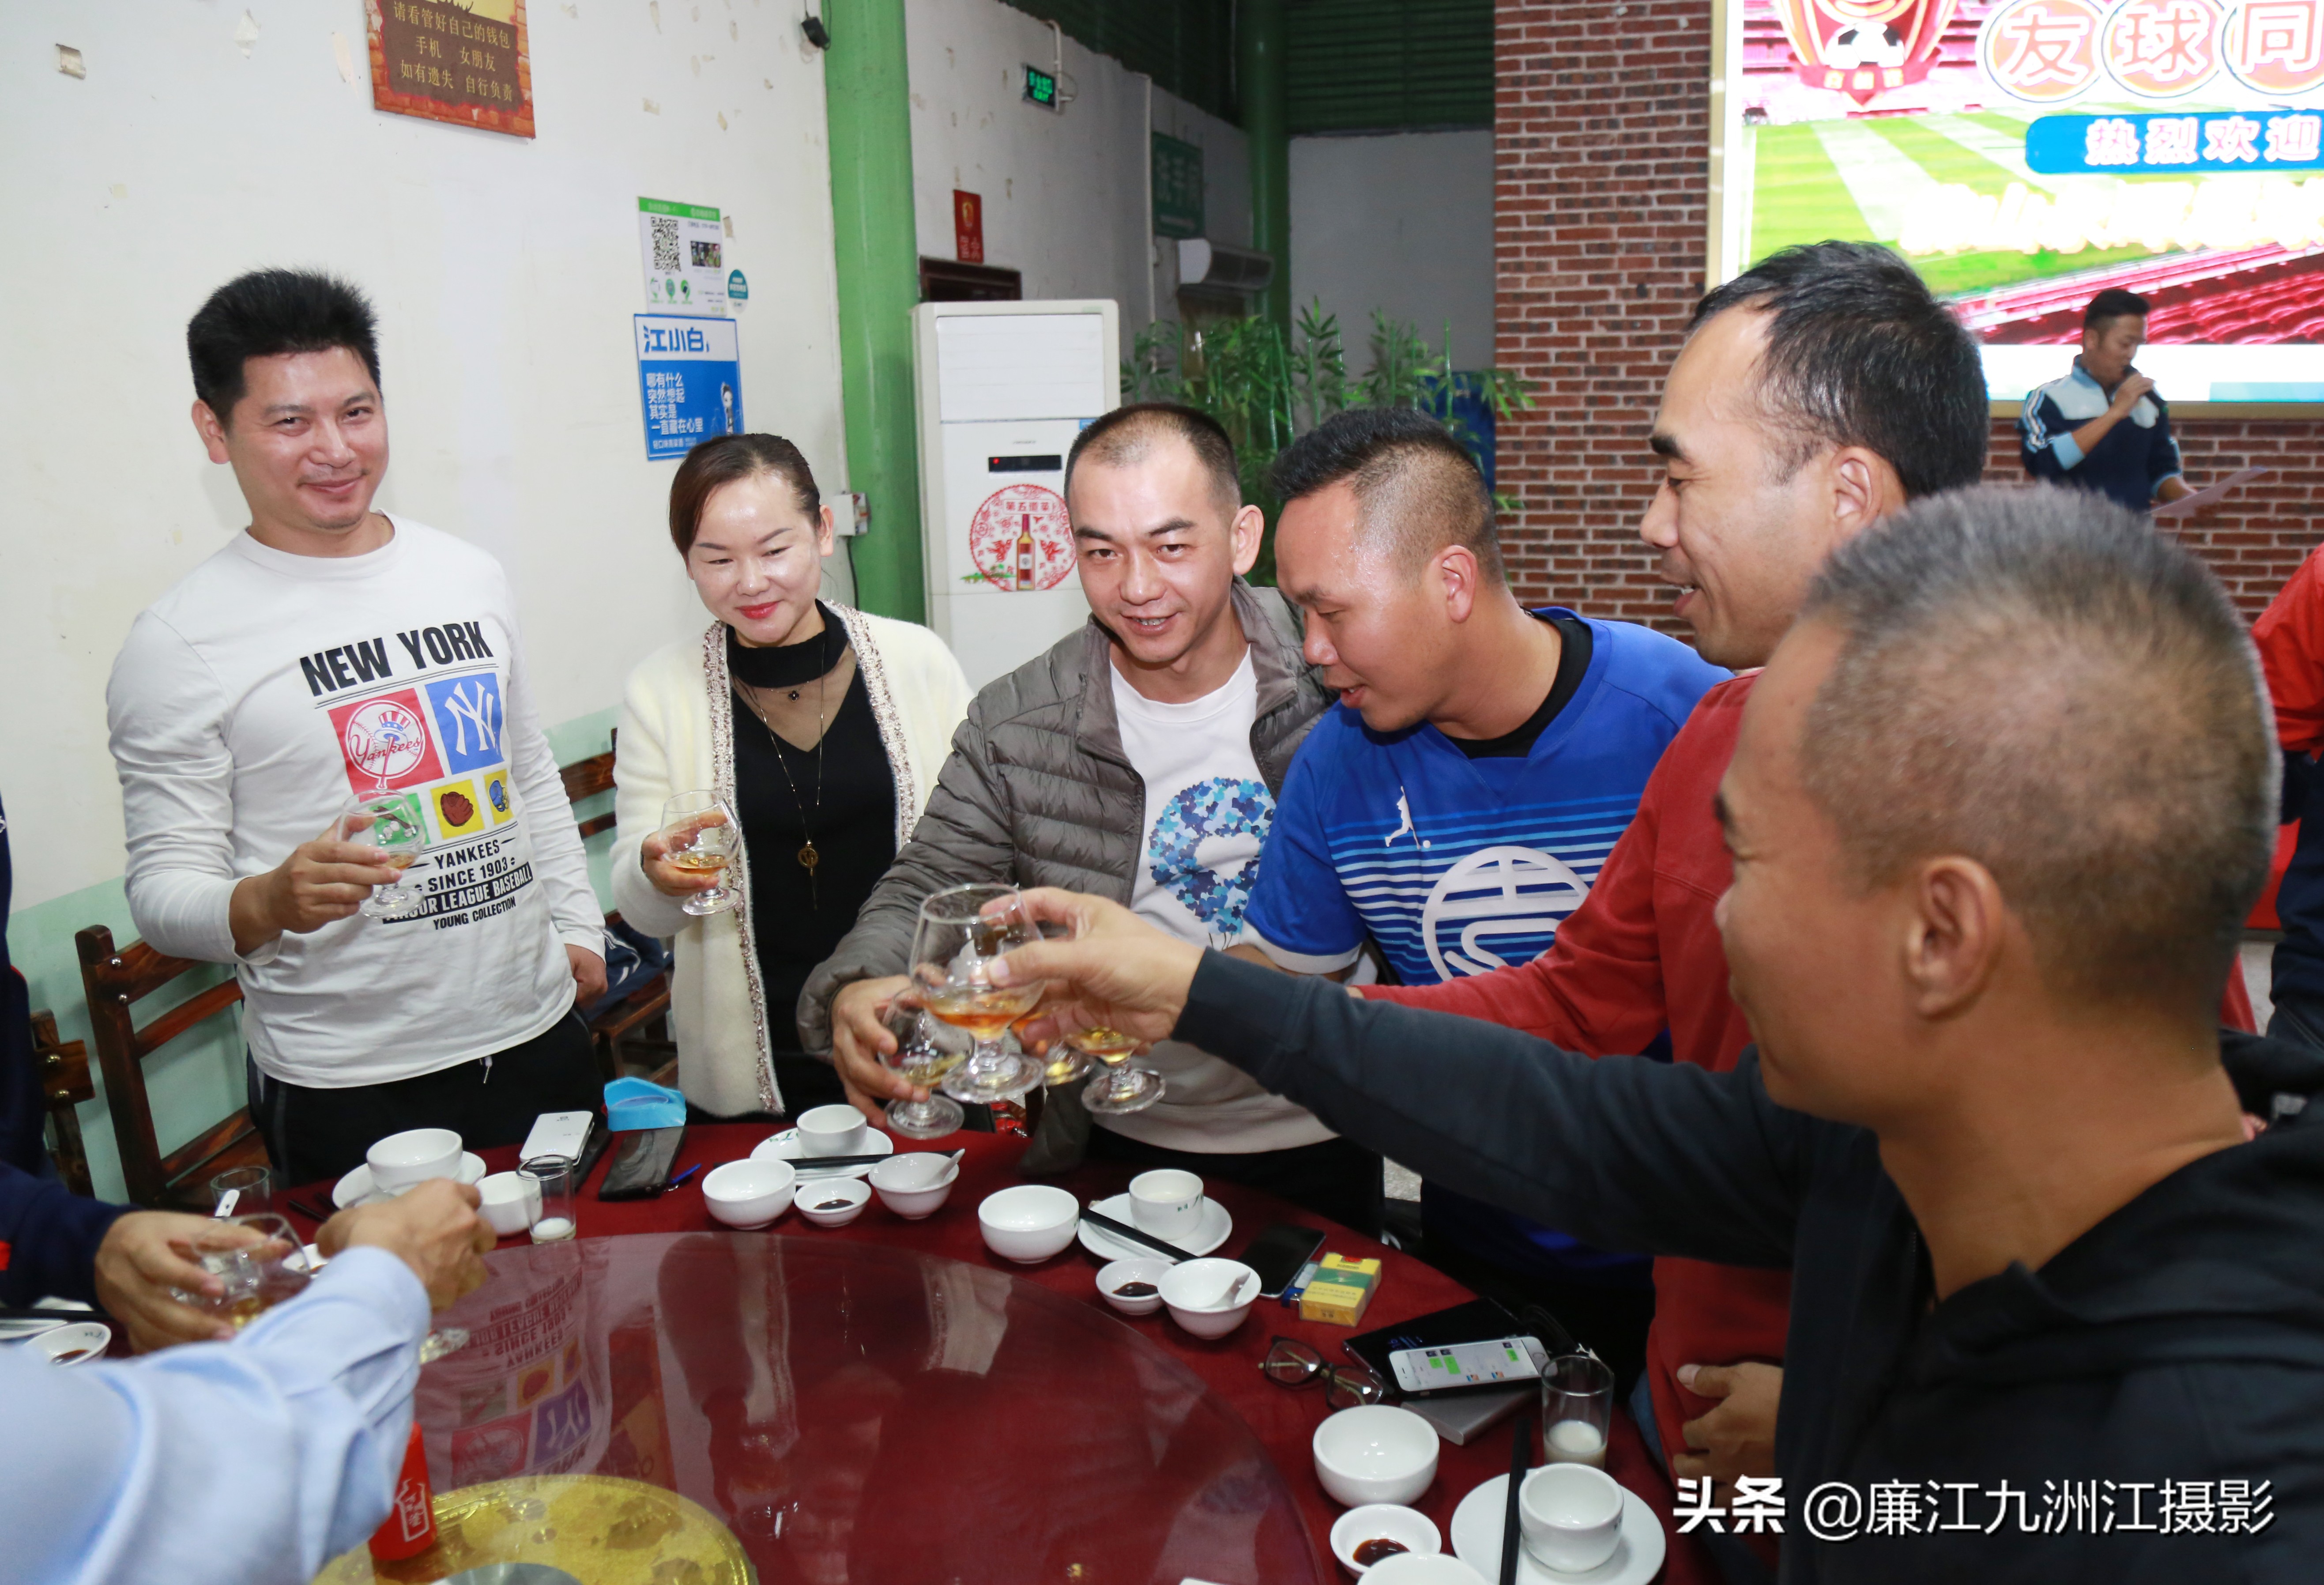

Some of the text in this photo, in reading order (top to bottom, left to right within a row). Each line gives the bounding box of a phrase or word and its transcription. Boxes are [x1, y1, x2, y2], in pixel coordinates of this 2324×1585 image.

[394, 1, 510, 49] 请看管好自己的钱包
[416, 36, 496, 72] 手机 女朋友
[400, 60, 512, 102] 如有遗失 自行负责
[2084, 114, 2322, 165] 热烈欢迎
[649, 404, 677, 419] 其实是
[300, 622, 493, 697] NEW YORK
[434, 839, 501, 870] YANKEES
[429, 857, 509, 892] SINCE 1903
[441, 883, 491, 912] LEAGUE
[493, 867, 532, 899] BASEBALL
[433, 897, 516, 930] YOUNG COLLECTION
